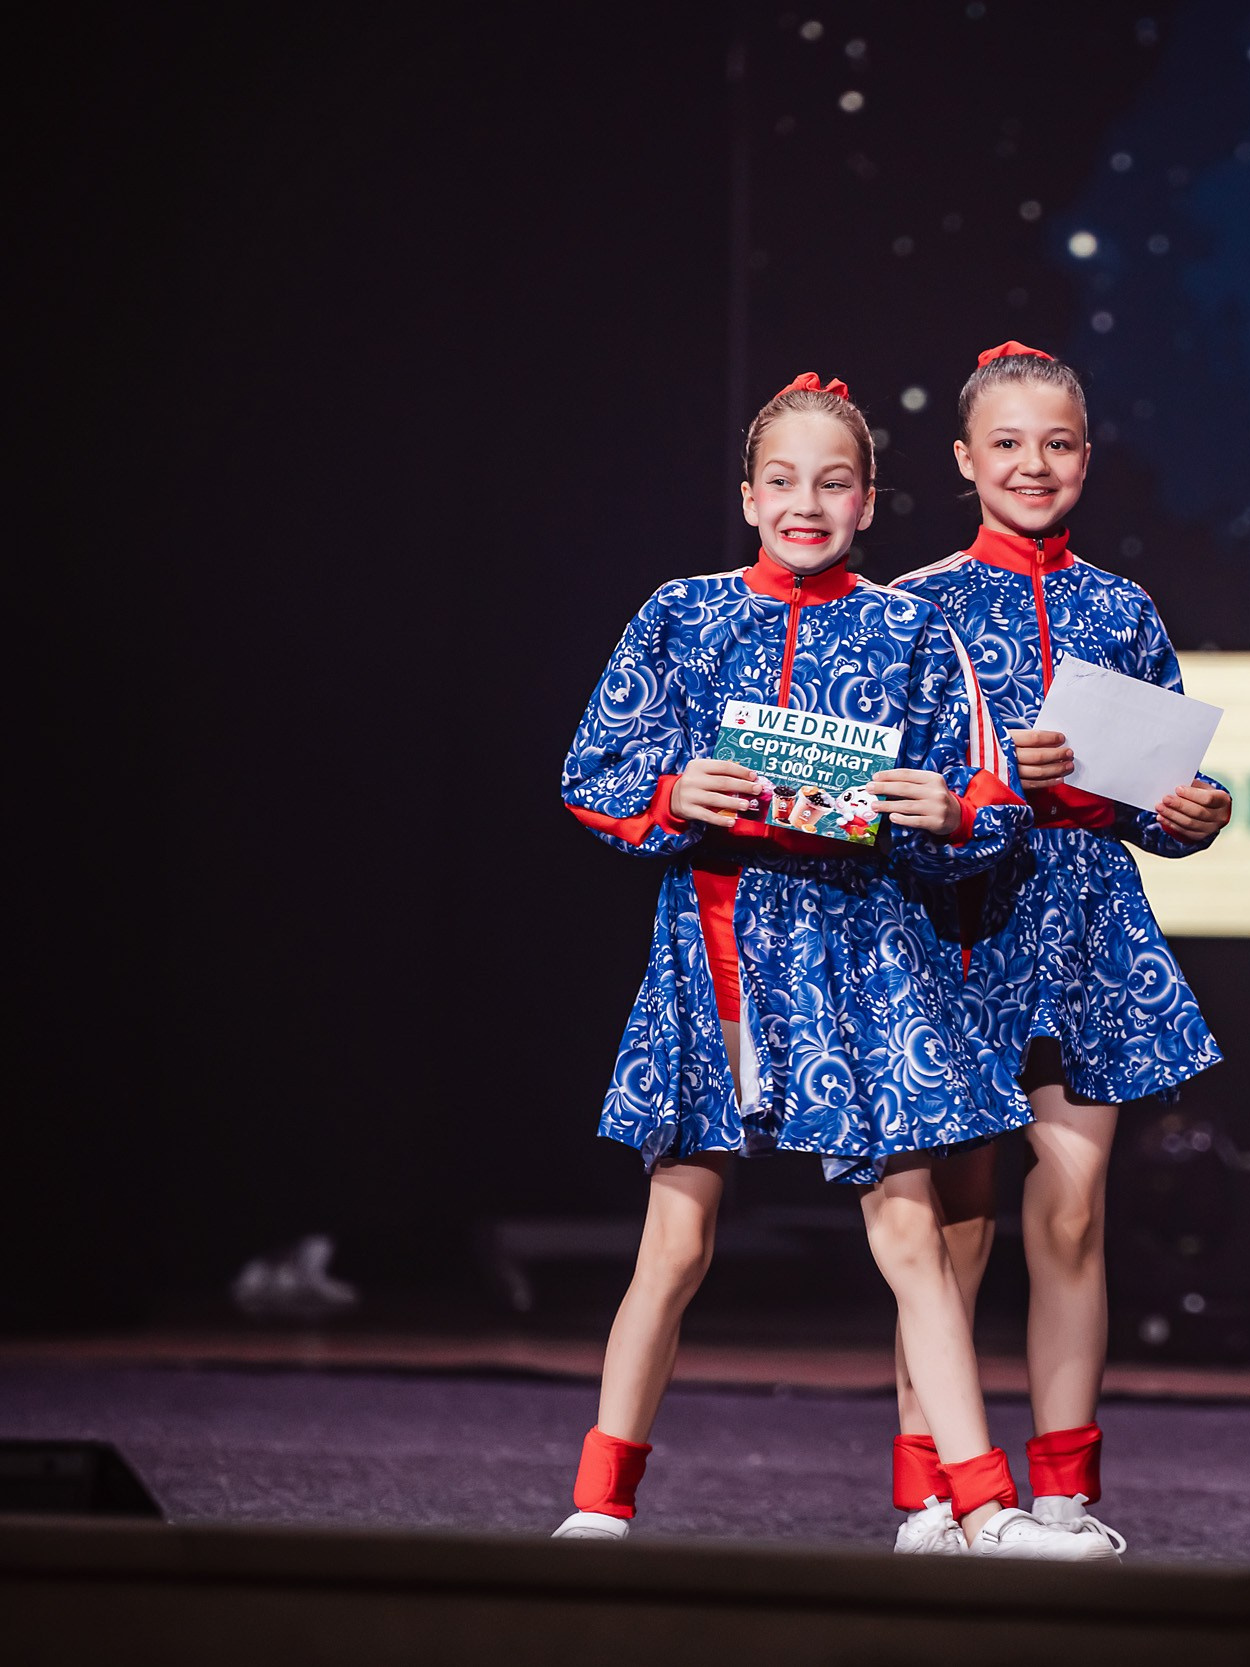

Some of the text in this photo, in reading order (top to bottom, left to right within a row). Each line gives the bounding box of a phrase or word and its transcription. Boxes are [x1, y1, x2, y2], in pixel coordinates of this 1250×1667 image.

[757, 708, 890, 752] WEDRINK
[738, 731, 874, 773] Сертификат
[766, 756, 778, 771] 3
[781, 760, 814, 778] 000
